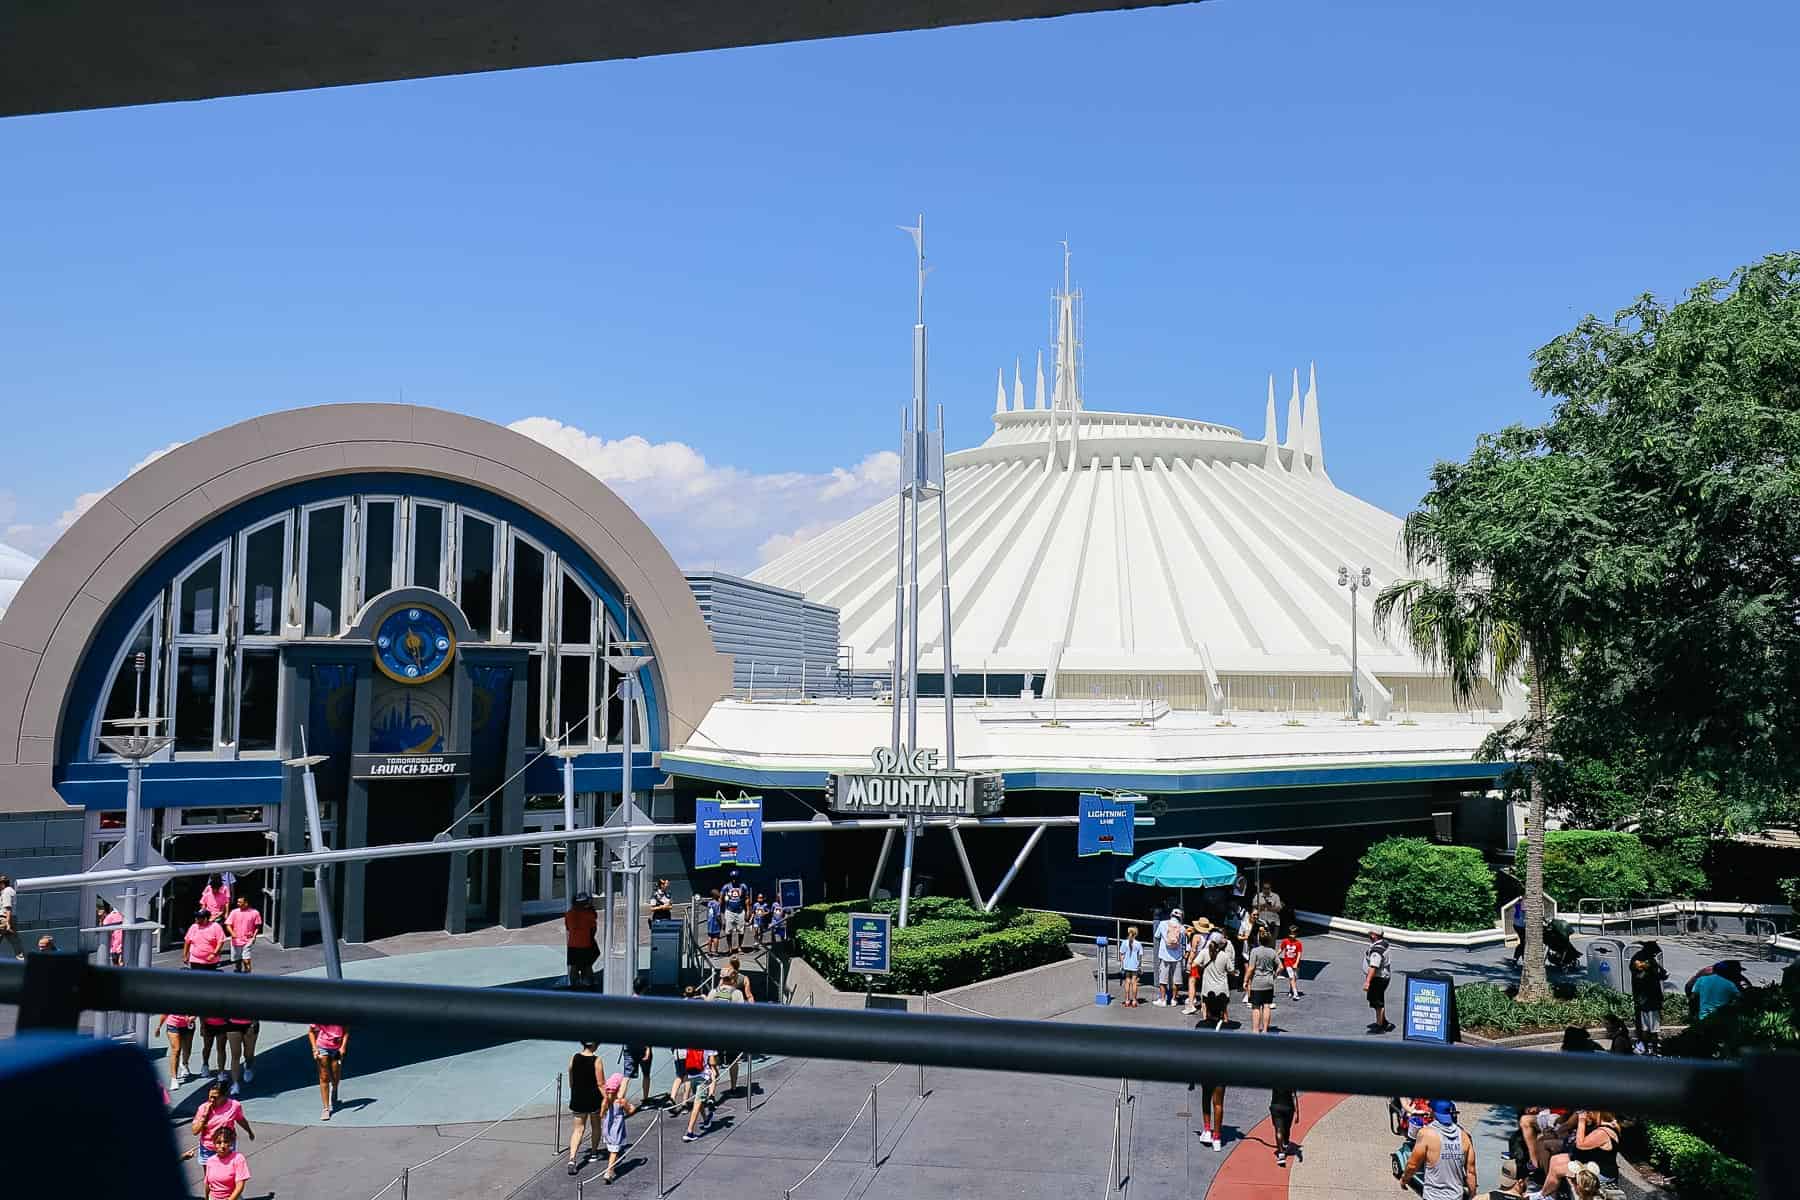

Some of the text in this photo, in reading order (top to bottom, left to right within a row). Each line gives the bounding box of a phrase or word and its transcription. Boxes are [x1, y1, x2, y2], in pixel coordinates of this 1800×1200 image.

[871, 743, 938, 775] SPACE
[370, 763, 457, 775] LAUNCH DEPOT
[846, 777, 965, 808] MOUNTAIN
[1087, 810, 1127, 818] LIGHTNING
[703, 818, 754, 828] STAND-BY
[708, 828, 750, 837] ENTRANCE
